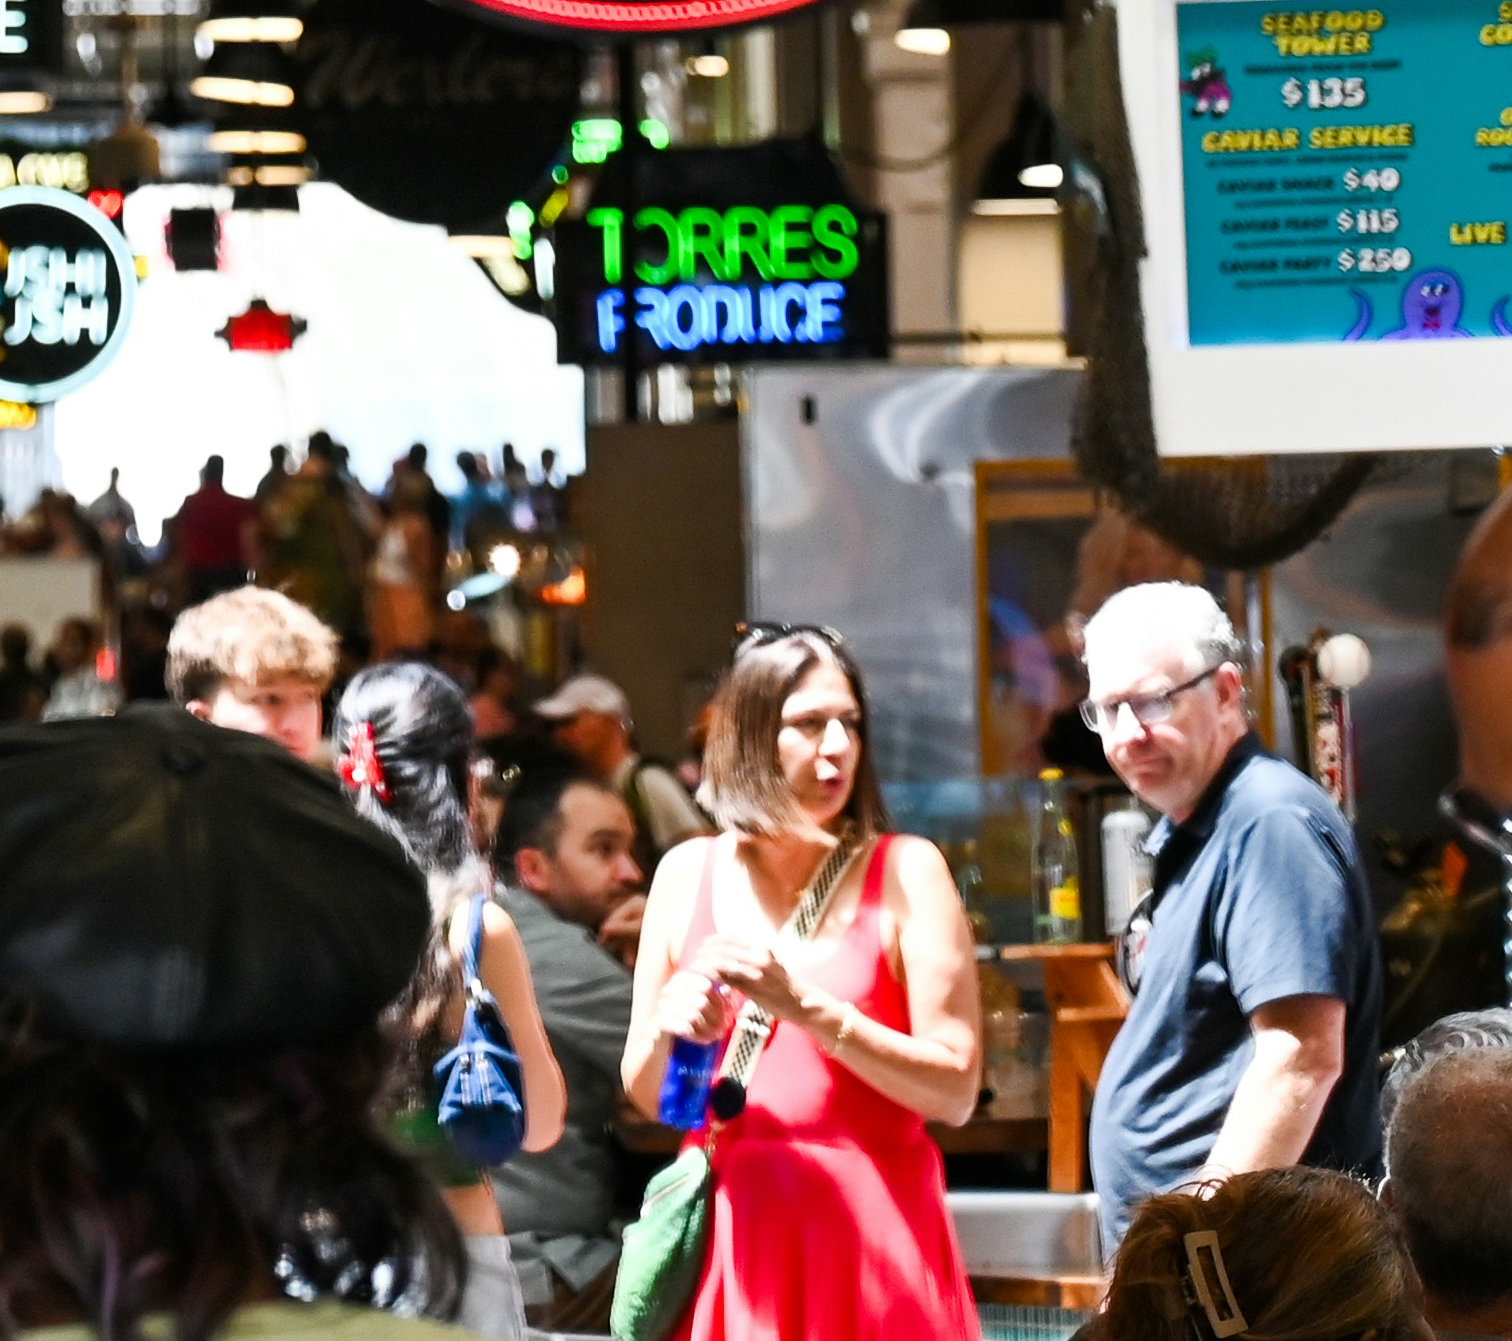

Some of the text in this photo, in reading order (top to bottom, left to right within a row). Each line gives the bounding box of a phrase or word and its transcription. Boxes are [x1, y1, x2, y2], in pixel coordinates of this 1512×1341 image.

[1261, 9, 1385, 35] SEAFOOD
[1276, 31, 1372, 56] TOWER
[1281, 76, 1366, 109] $135
[1201, 123, 1415, 153] CAVIAR SERVICE
[1343, 167, 1400, 192] $40
[1449, 221, 1507, 245] LIVE
[1337, 247, 1413, 274] $250
